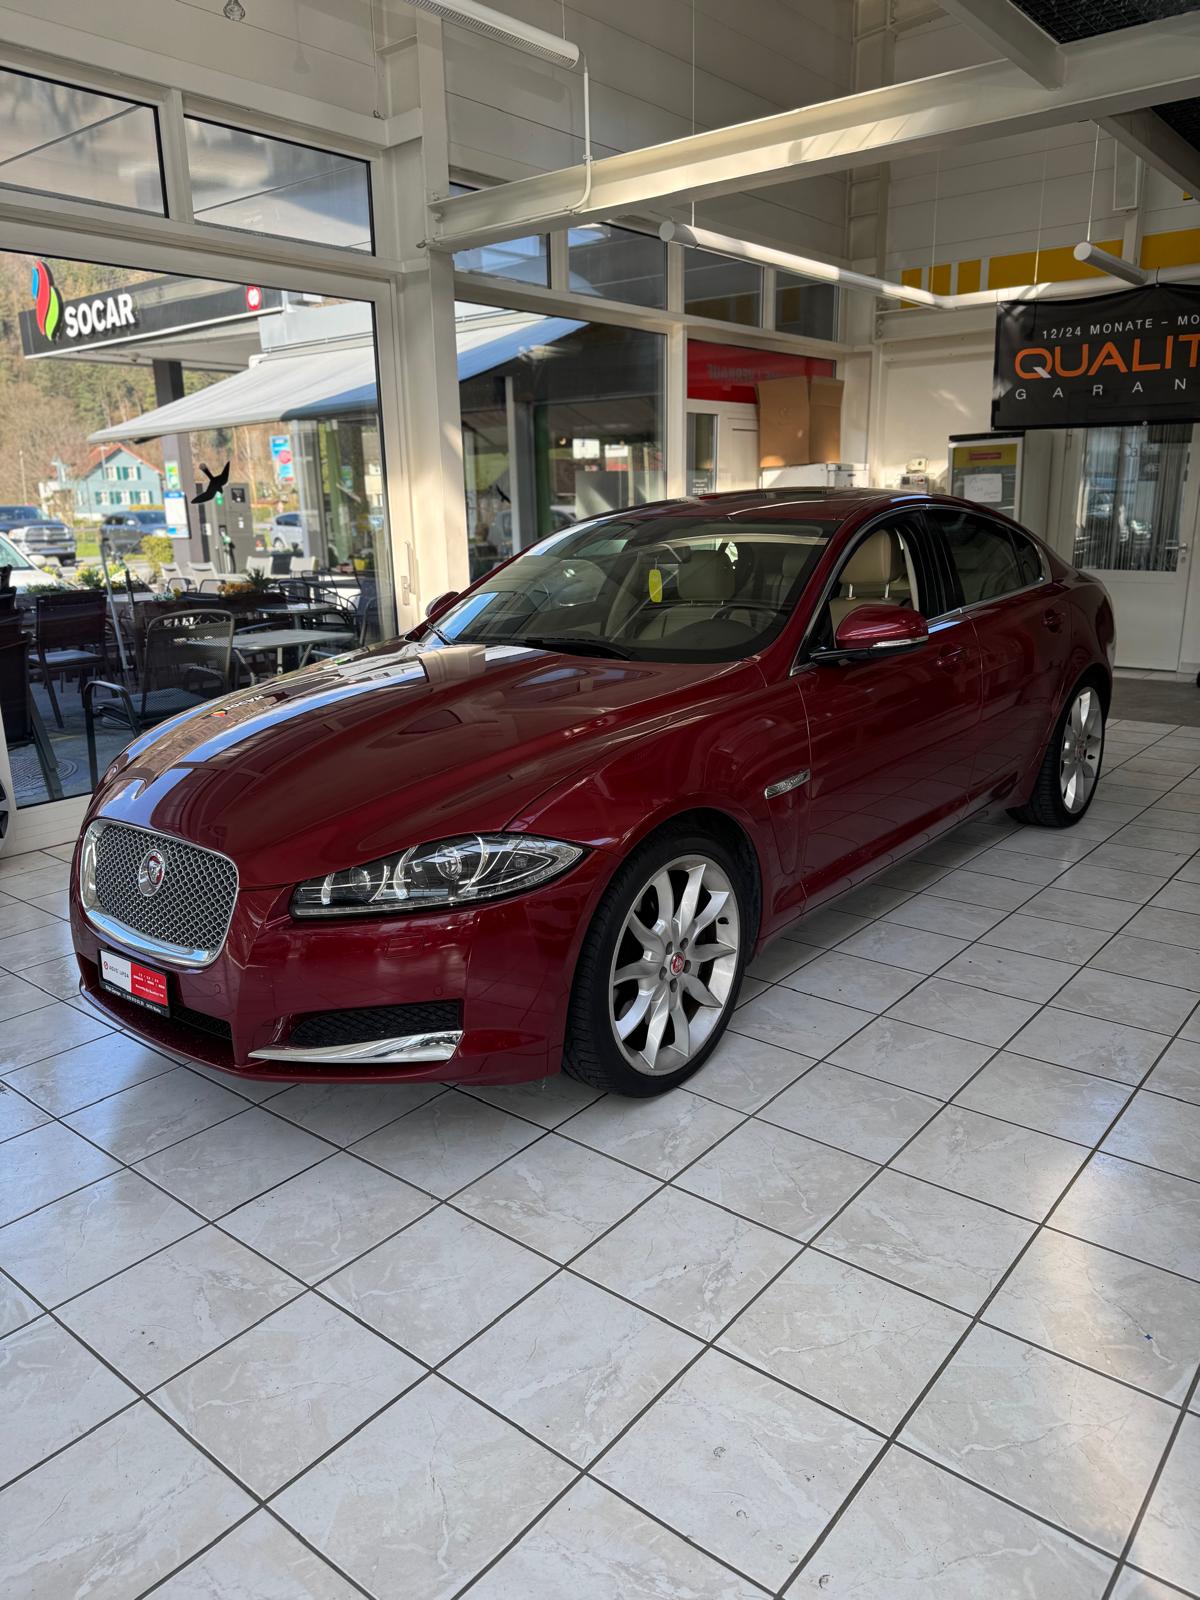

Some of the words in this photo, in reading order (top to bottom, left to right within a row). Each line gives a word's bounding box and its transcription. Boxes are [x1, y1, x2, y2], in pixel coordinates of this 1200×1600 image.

[64, 293, 136, 338] SOCAR
[1042, 326, 1082, 340] 12/24
[1090, 318, 1153, 335] MONATE
[1177, 314, 1200, 325] MO
[1014, 333, 1200, 380] QUALIT
